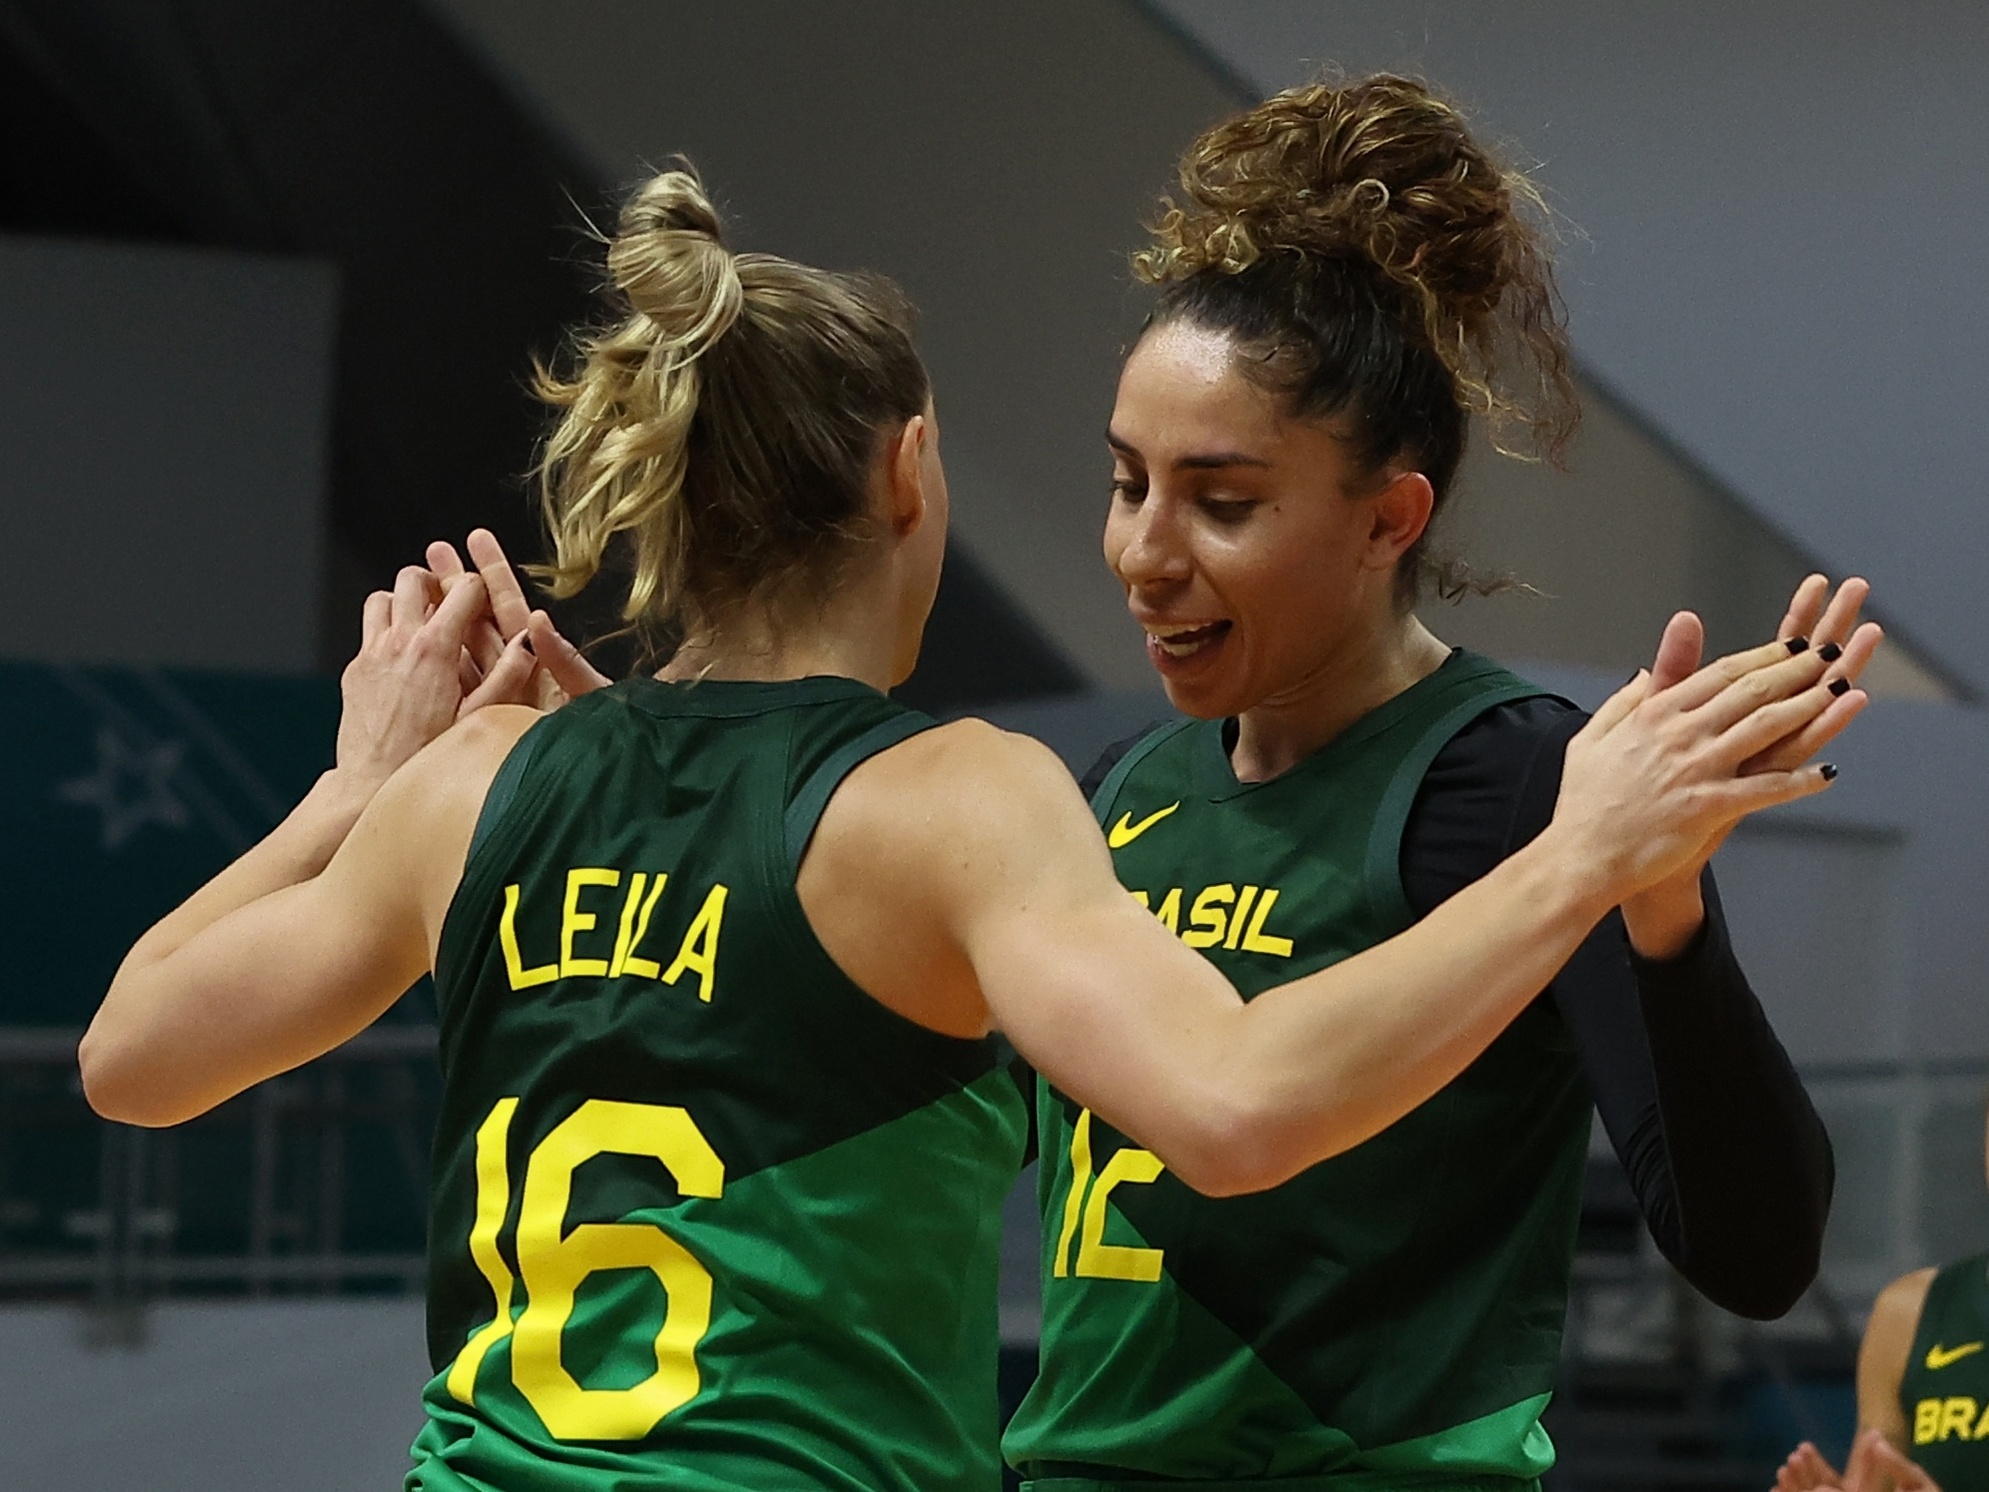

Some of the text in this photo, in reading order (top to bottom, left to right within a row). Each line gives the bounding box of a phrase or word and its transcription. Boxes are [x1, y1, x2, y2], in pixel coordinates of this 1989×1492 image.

[500, 868, 728, 1003] LEILA
[1130, 884, 1294, 957] ASIL
[446, 1097, 725, 1440] 16
